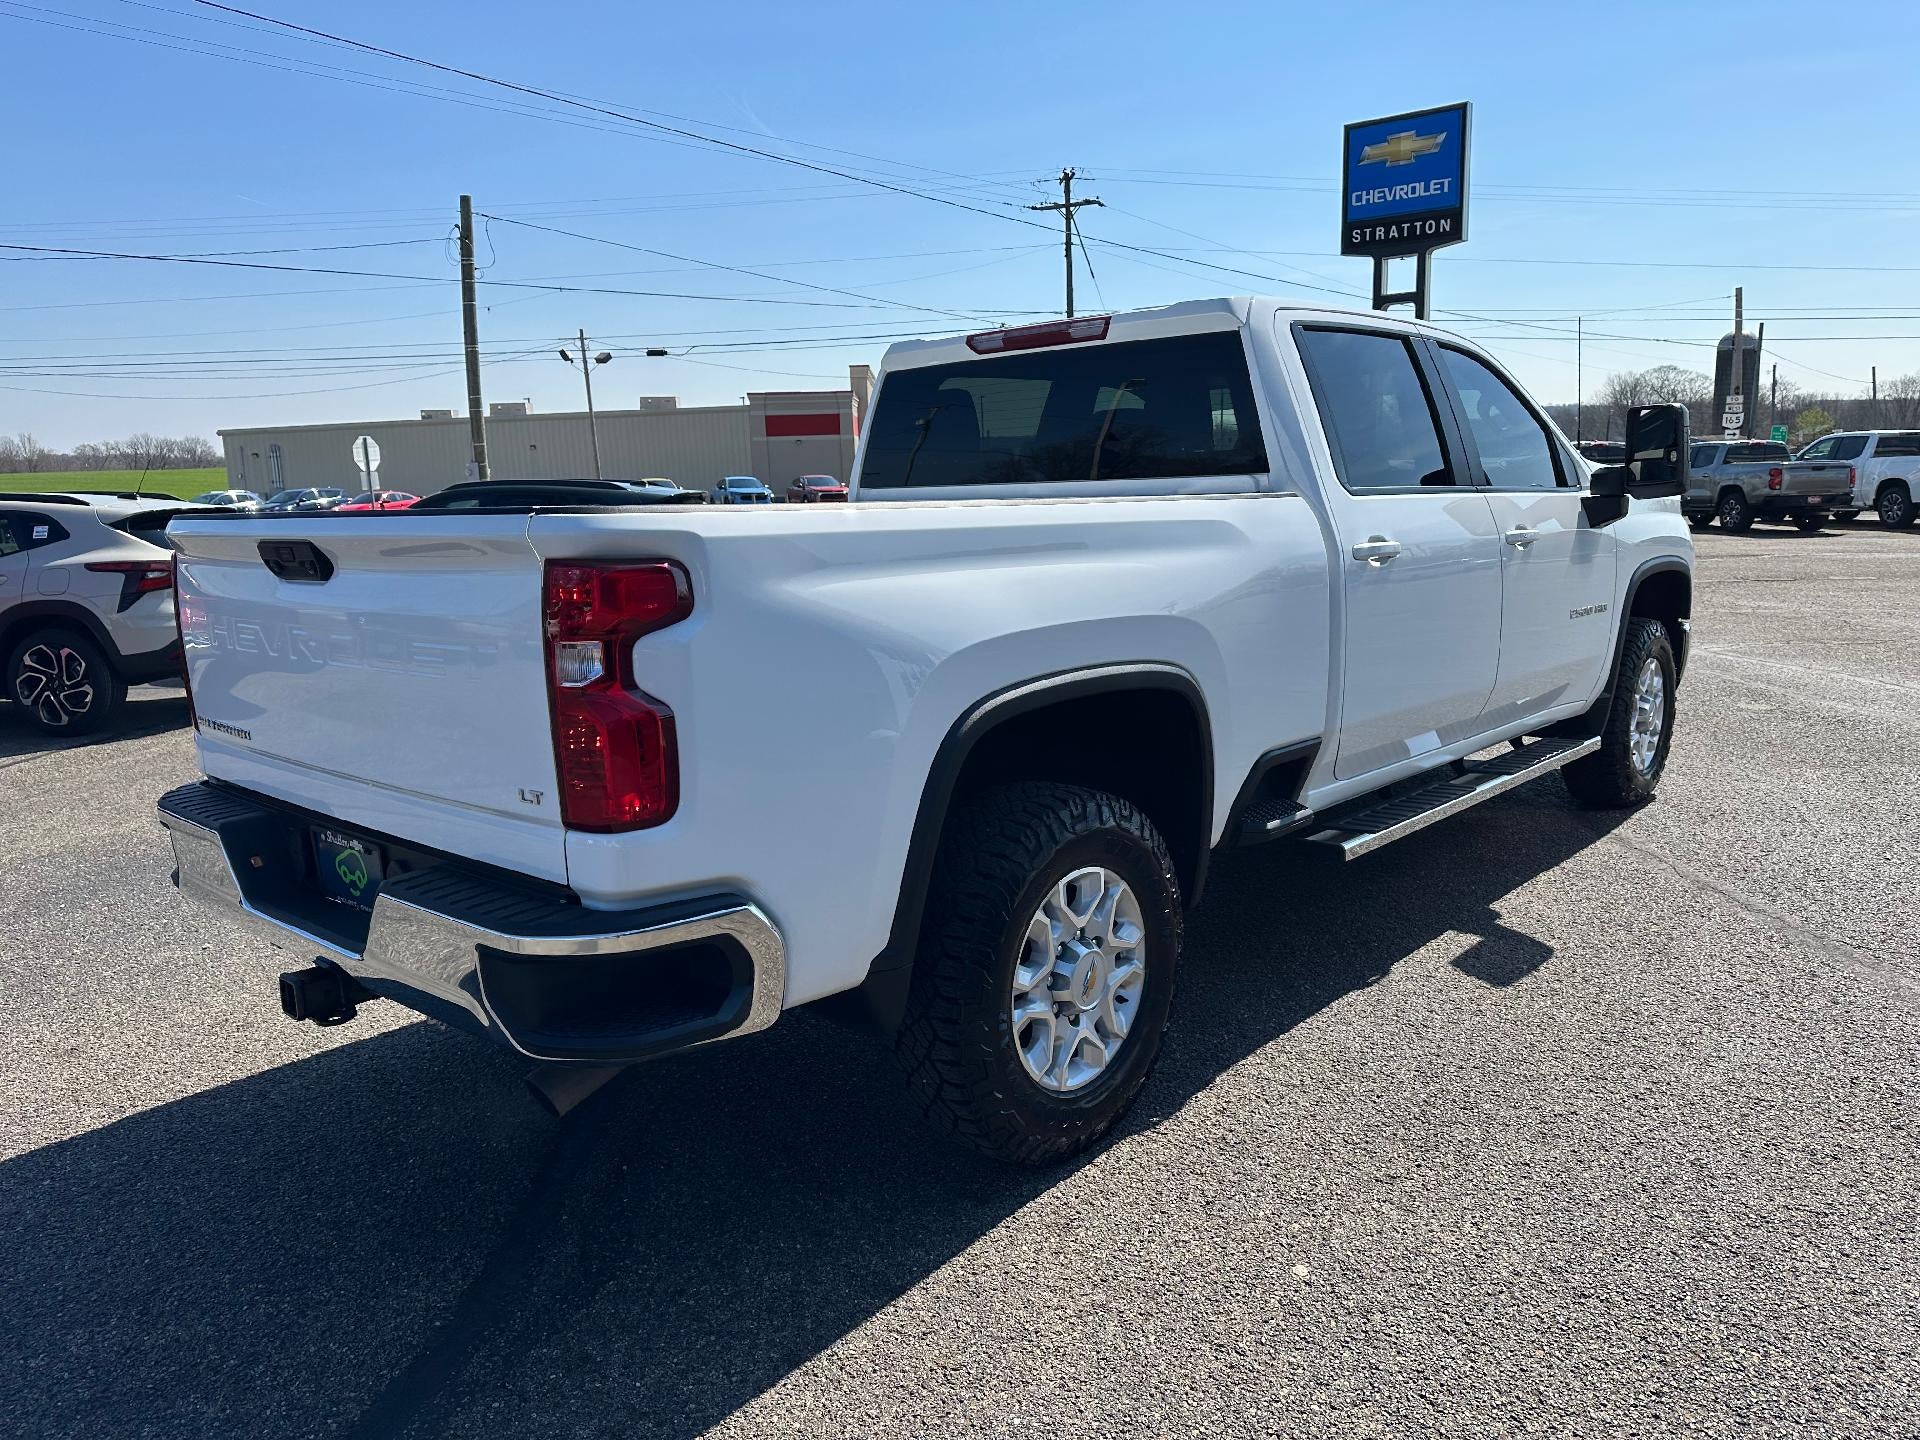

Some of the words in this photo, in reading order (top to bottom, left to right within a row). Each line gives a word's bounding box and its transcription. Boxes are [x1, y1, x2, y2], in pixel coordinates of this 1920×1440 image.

[1352, 178, 1452, 207] CHEVROLET
[1352, 218, 1451, 243] STRATTON
[1725, 416, 1741, 424] 165
[187, 612, 497, 685] HEVROLET
[517, 787, 544, 806] LT
